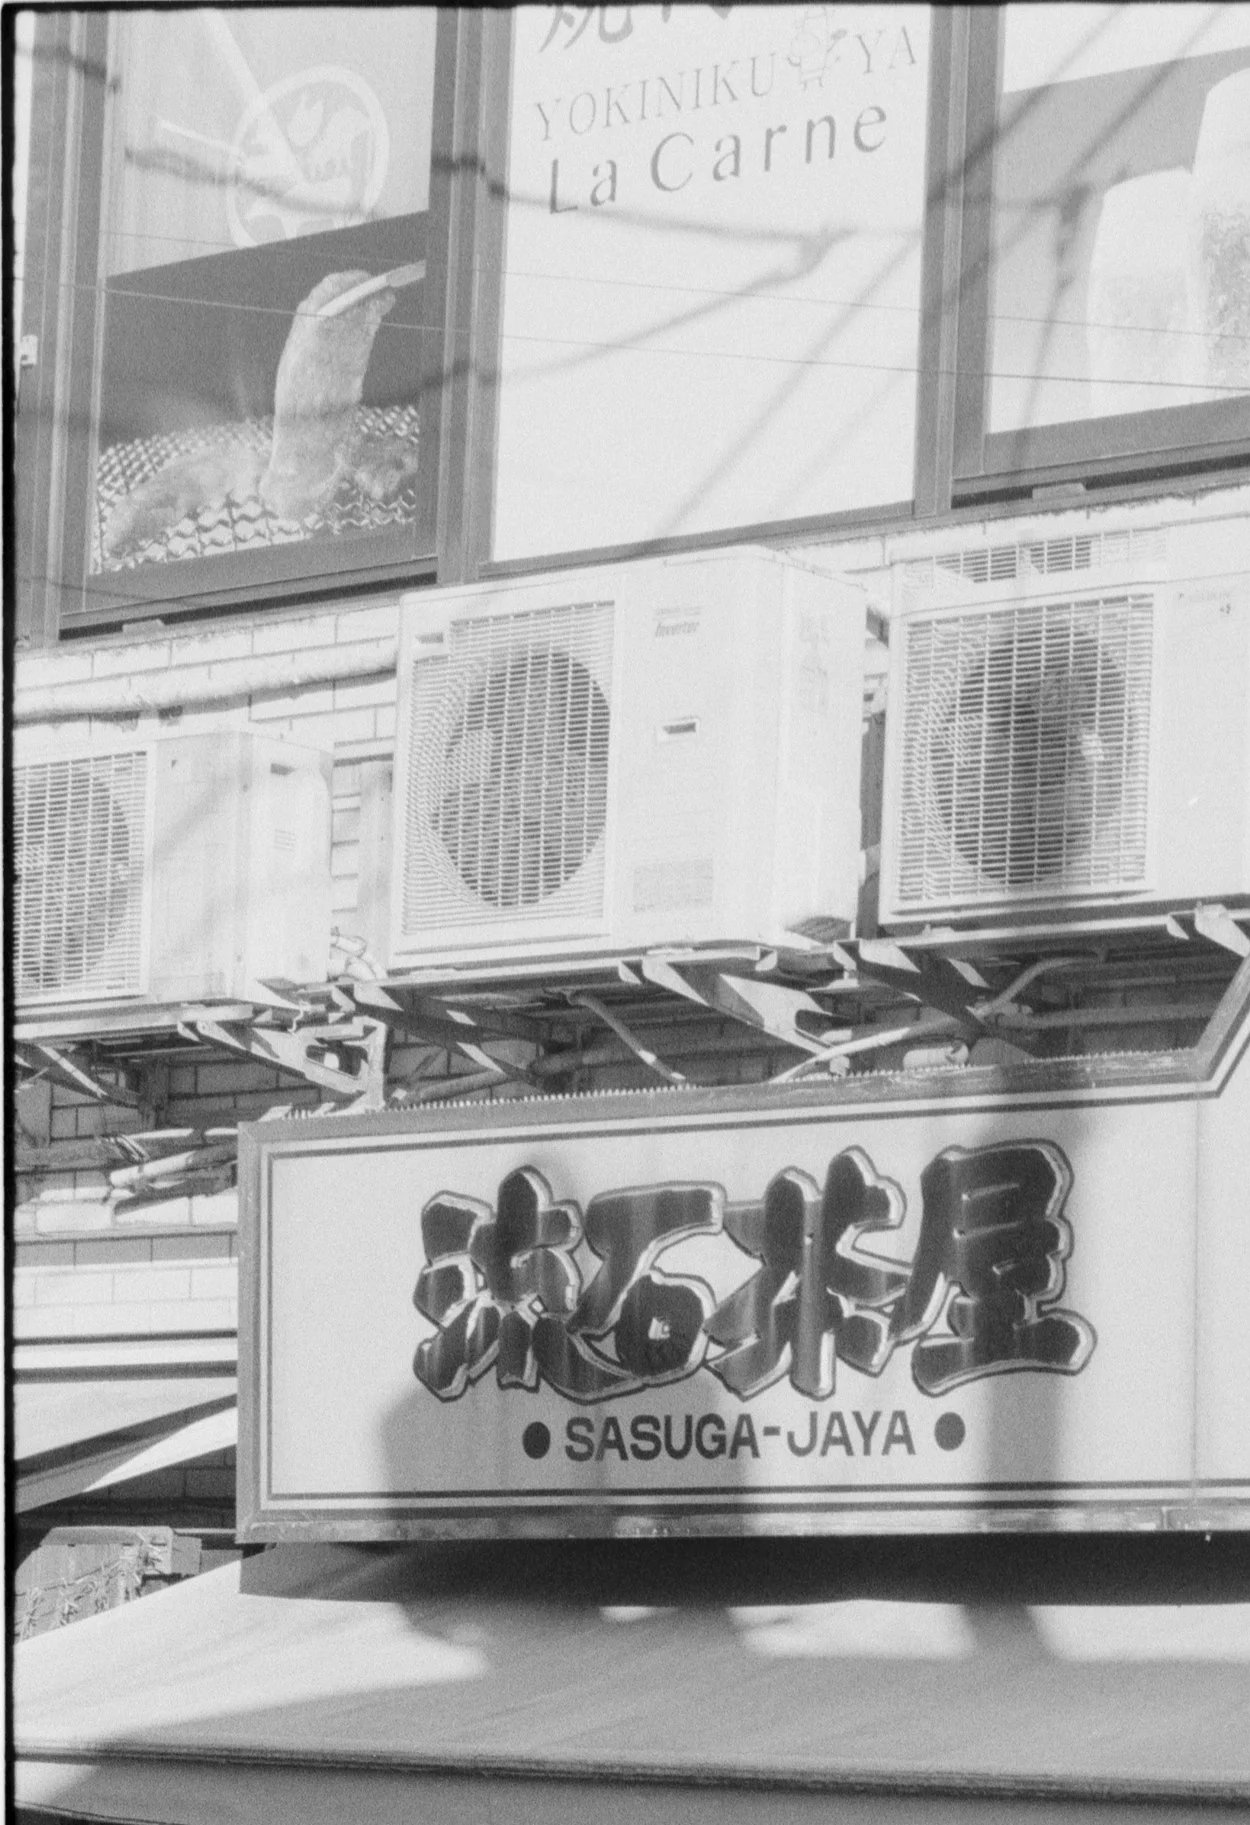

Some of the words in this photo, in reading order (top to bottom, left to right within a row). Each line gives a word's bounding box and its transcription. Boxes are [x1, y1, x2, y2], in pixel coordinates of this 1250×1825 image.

[532, 52, 777, 141] YOKINIKU
[854, 25, 917, 75] YA
[549, 158, 619, 215] La
[650, 105, 888, 192] Carne
[565, 1411, 917, 1463] SASUGA-JAYA
